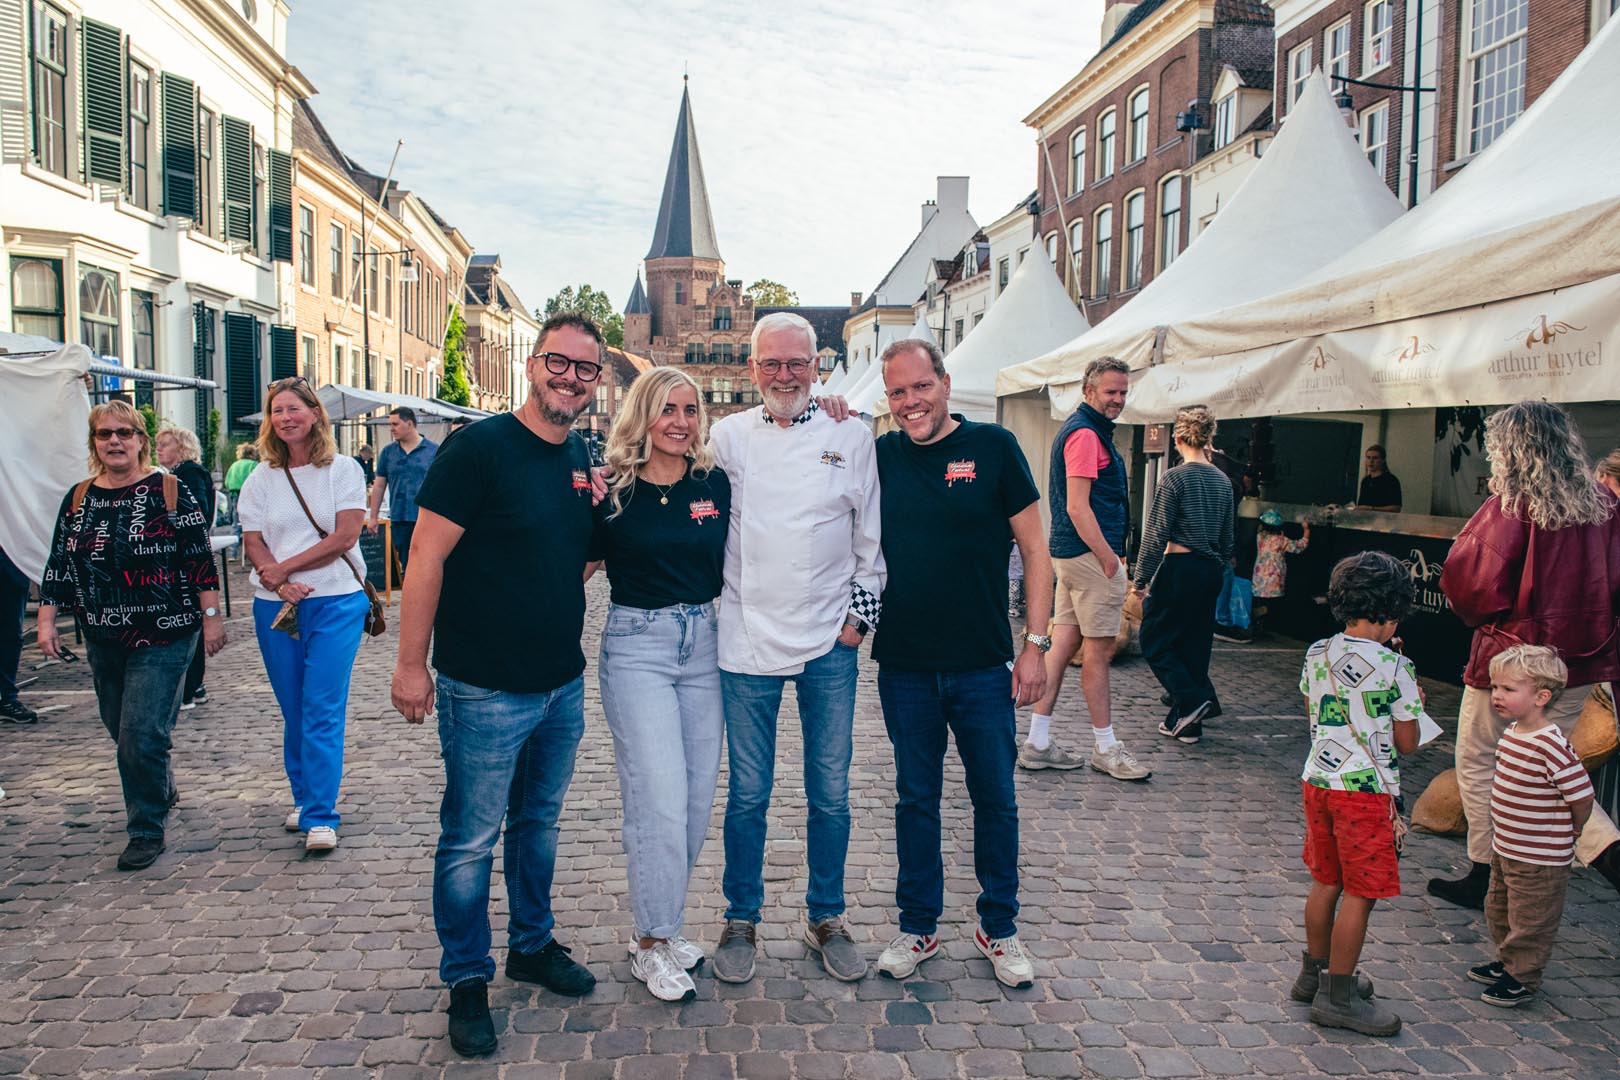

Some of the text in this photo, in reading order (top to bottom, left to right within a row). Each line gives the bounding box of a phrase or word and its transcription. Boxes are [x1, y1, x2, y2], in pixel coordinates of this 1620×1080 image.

[1488, 341, 1602, 376] arthur tuytel
[128, 485, 149, 542] ORANGE
[90, 520, 110, 560] Purple
[134, 542, 177, 555] dark red
[87, 612, 132, 626] BLACK
[103, 603, 144, 614] medium
